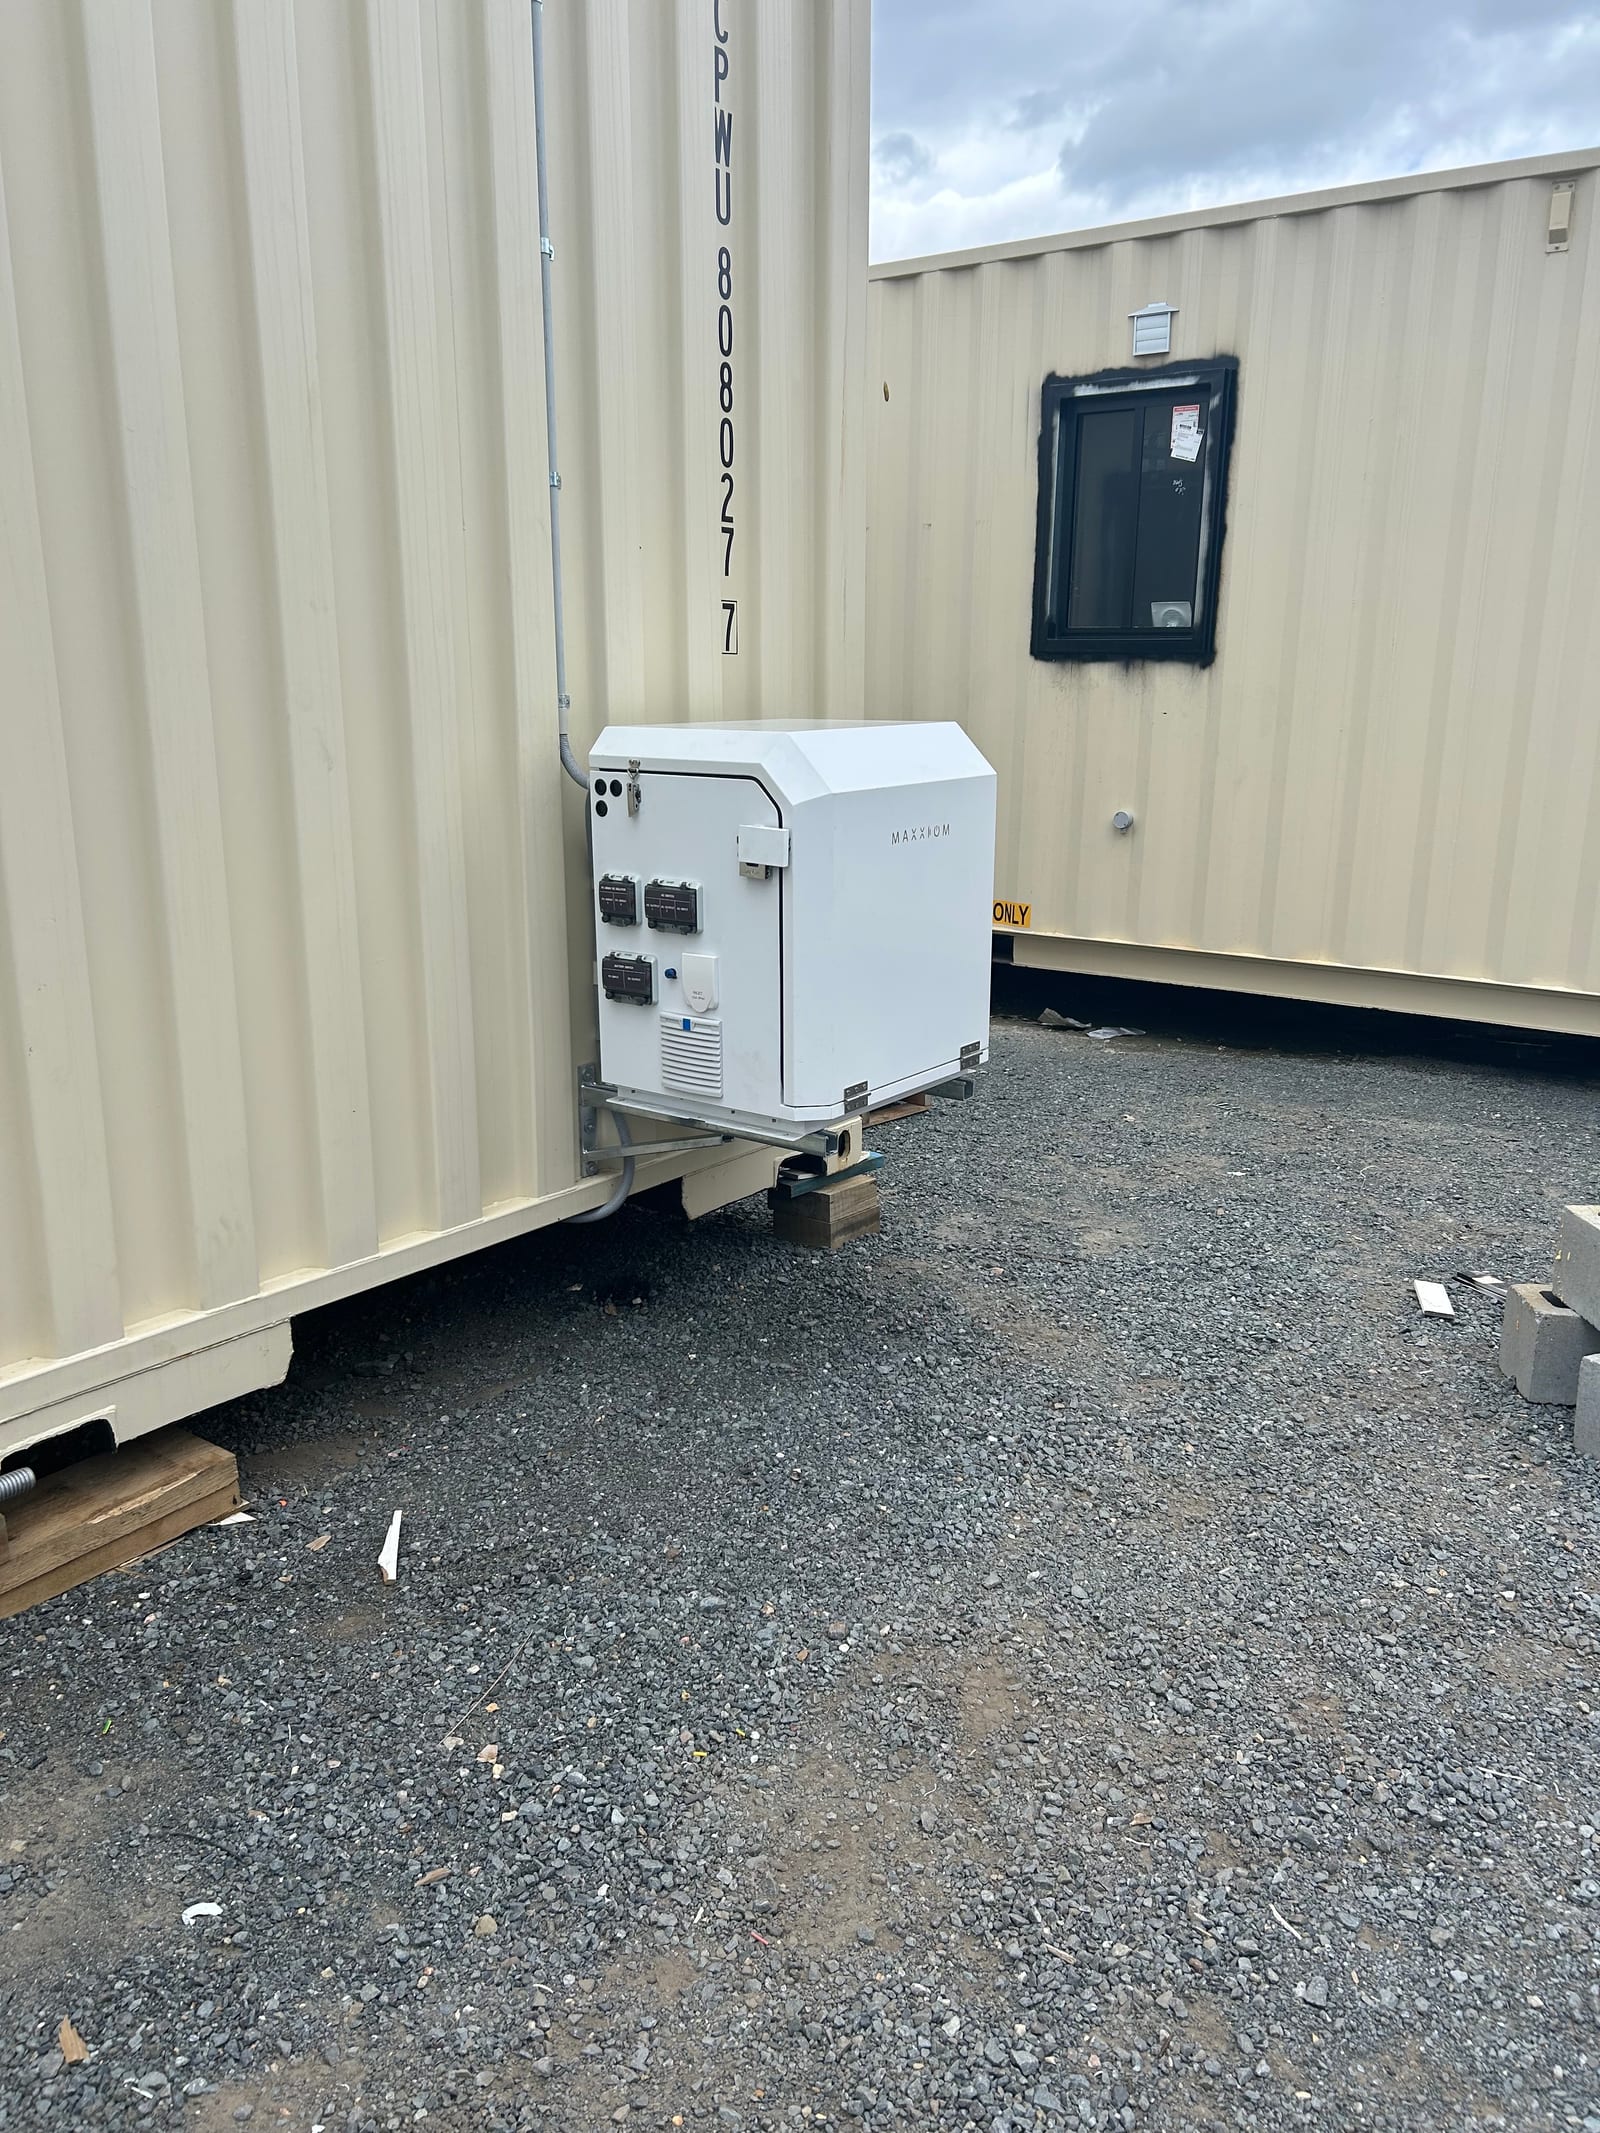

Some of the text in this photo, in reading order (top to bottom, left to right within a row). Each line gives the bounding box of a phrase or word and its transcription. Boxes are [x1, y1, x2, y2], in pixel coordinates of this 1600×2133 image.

[718, 246, 735, 577] 808027
[722, 602, 735, 652] 7
[891, 823, 950, 845] MAXXIOM
[993, 902, 1029, 926] ONLY
